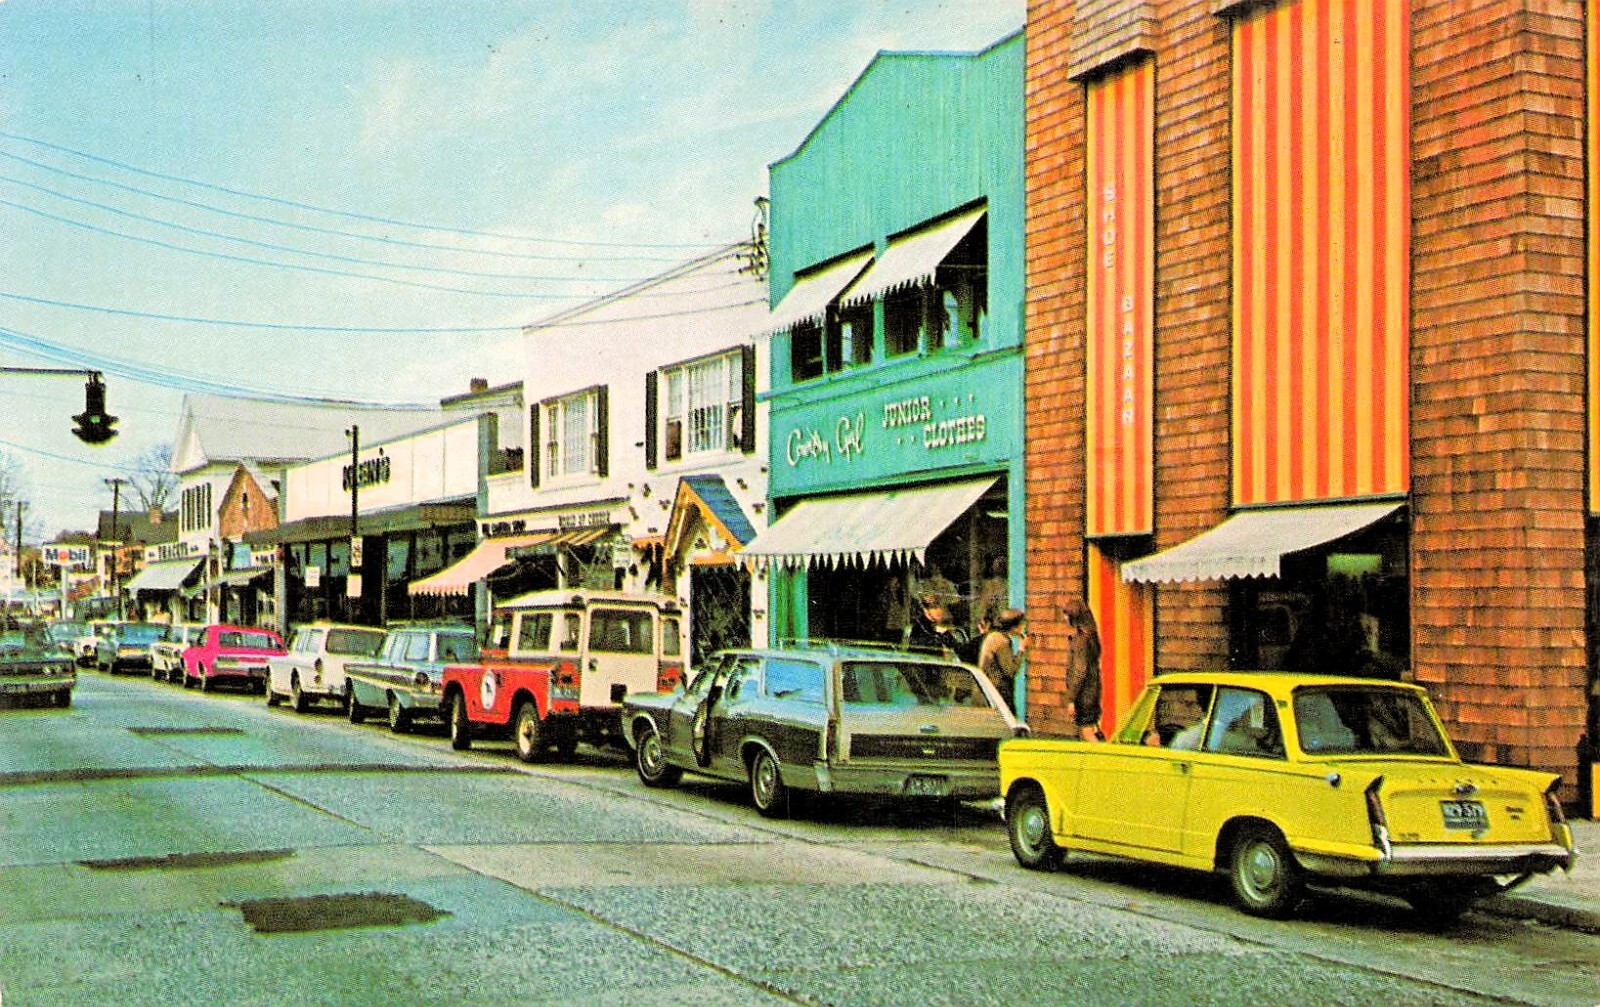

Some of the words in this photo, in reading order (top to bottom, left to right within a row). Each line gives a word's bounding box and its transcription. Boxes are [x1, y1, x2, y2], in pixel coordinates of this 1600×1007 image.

[1103, 184, 1116, 269] SHOE
[1122, 296, 1135, 425] BAZAAR
[882, 396, 931, 428] JUNIOR
[924, 414, 986, 448] CLOTHES
[45, 548, 87, 563] Mobil
